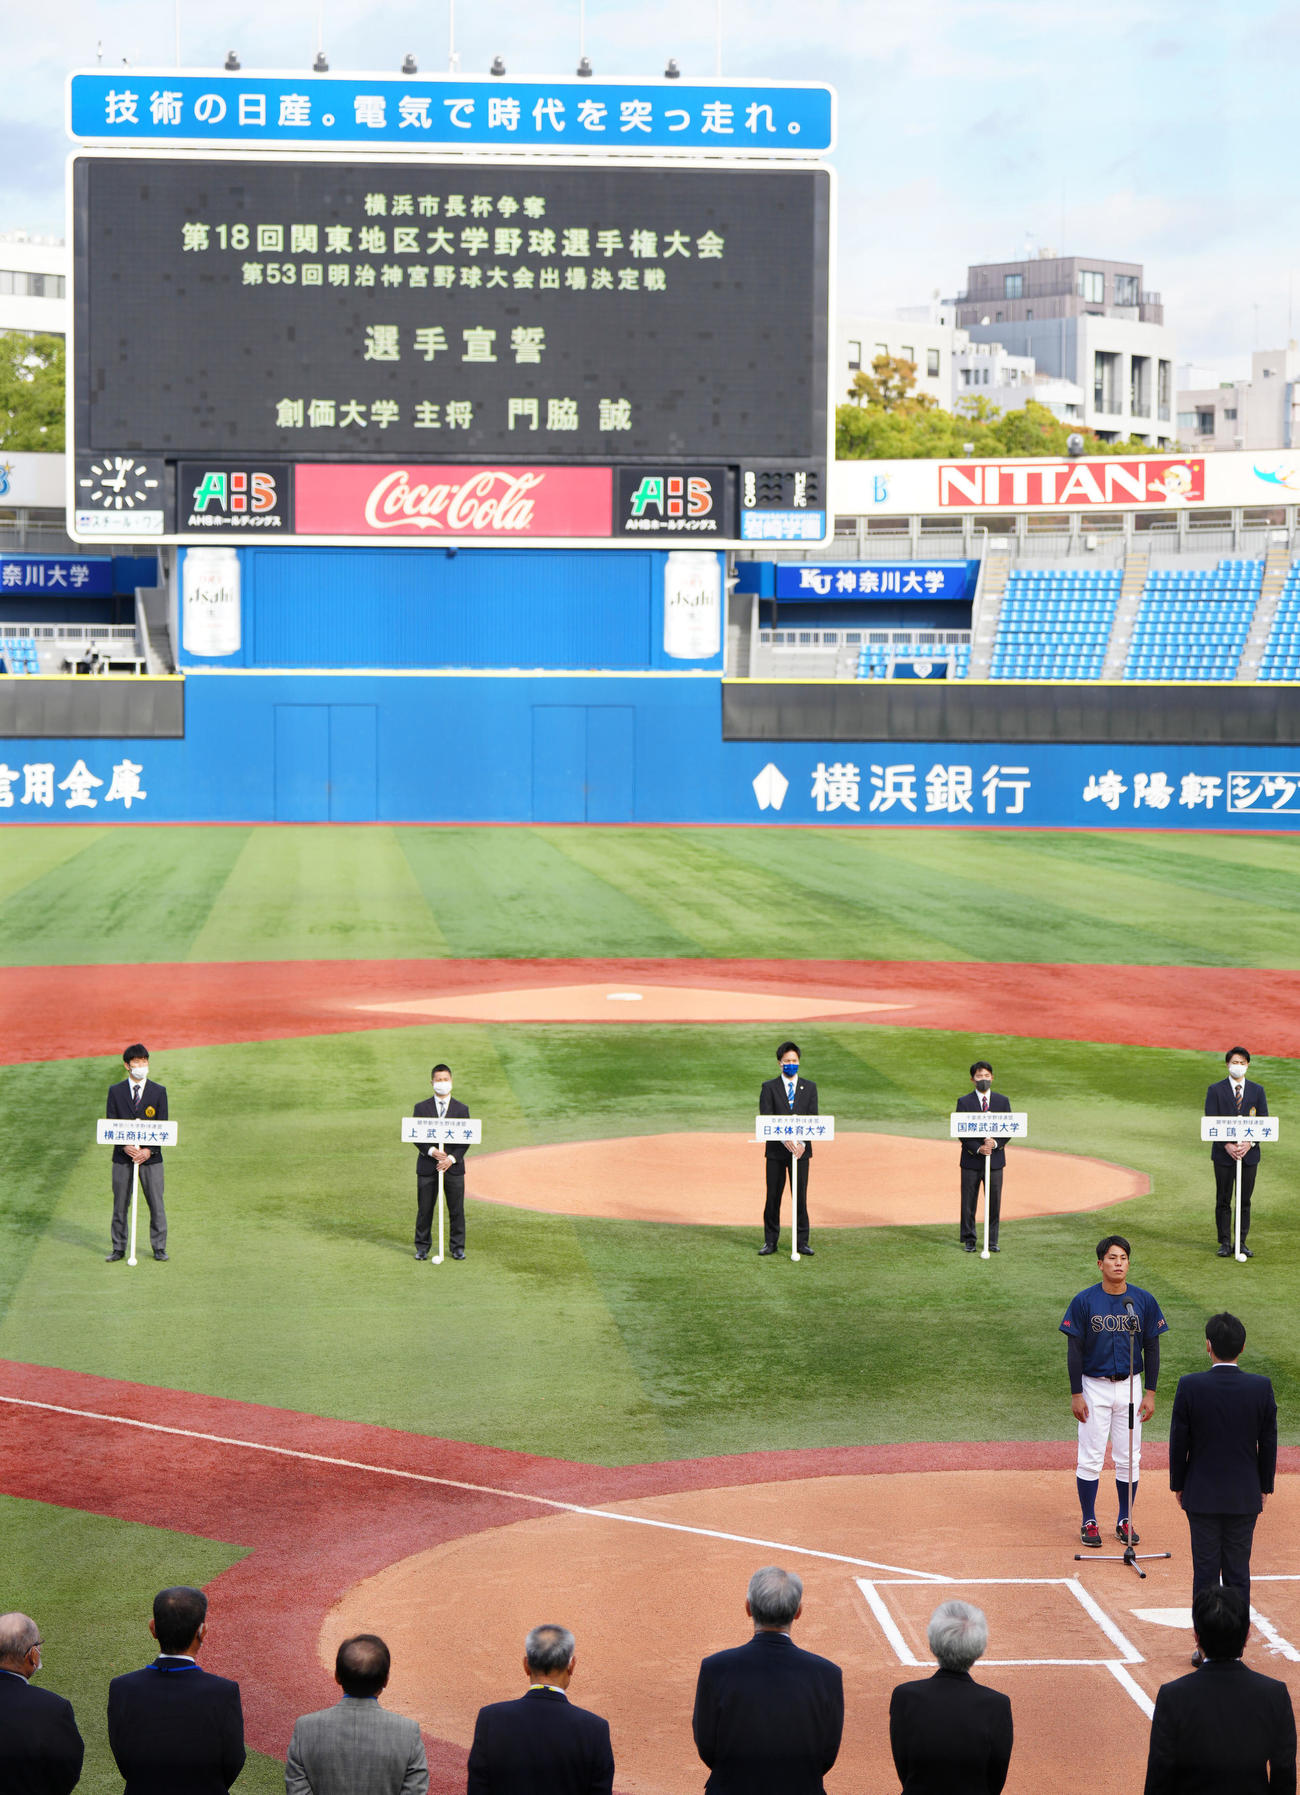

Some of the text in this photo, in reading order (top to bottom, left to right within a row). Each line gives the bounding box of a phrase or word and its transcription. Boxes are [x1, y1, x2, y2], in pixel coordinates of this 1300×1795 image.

[104, 90, 802, 135] 技術の日産。電気で時代を突っ走れ。
[364, 193, 546, 218] 横浜市長杯争奪
[181, 222, 725, 260] 第18回関東地区大学野球選手権大会
[241, 261, 667, 292] 第53回明治神宮野球大会出場決定戦
[363, 323, 547, 364] 選手宣誓
[275, 398, 632, 431] 創価大学 主将 門脇 誠
[364, 470, 545, 530] Coca-Cola
[941, 464, 1147, 506] NITTAN
[1, 565, 90, 588] 奈川大学
[843, 571, 945, 593] 神奈川大学
[811, 762, 1032, 814] 横浜銀行
[1082, 769, 1224, 811] 崎陽軒
[1231, 776, 1300, 809] シウ
[104, 1130, 169, 1142] 横浜商科大学
[408, 1128, 473, 1139] 上武大学
[763, 1125, 826, 1136] 日本体育大学
[957, 1122, 1020, 1133] 国際武道大学
